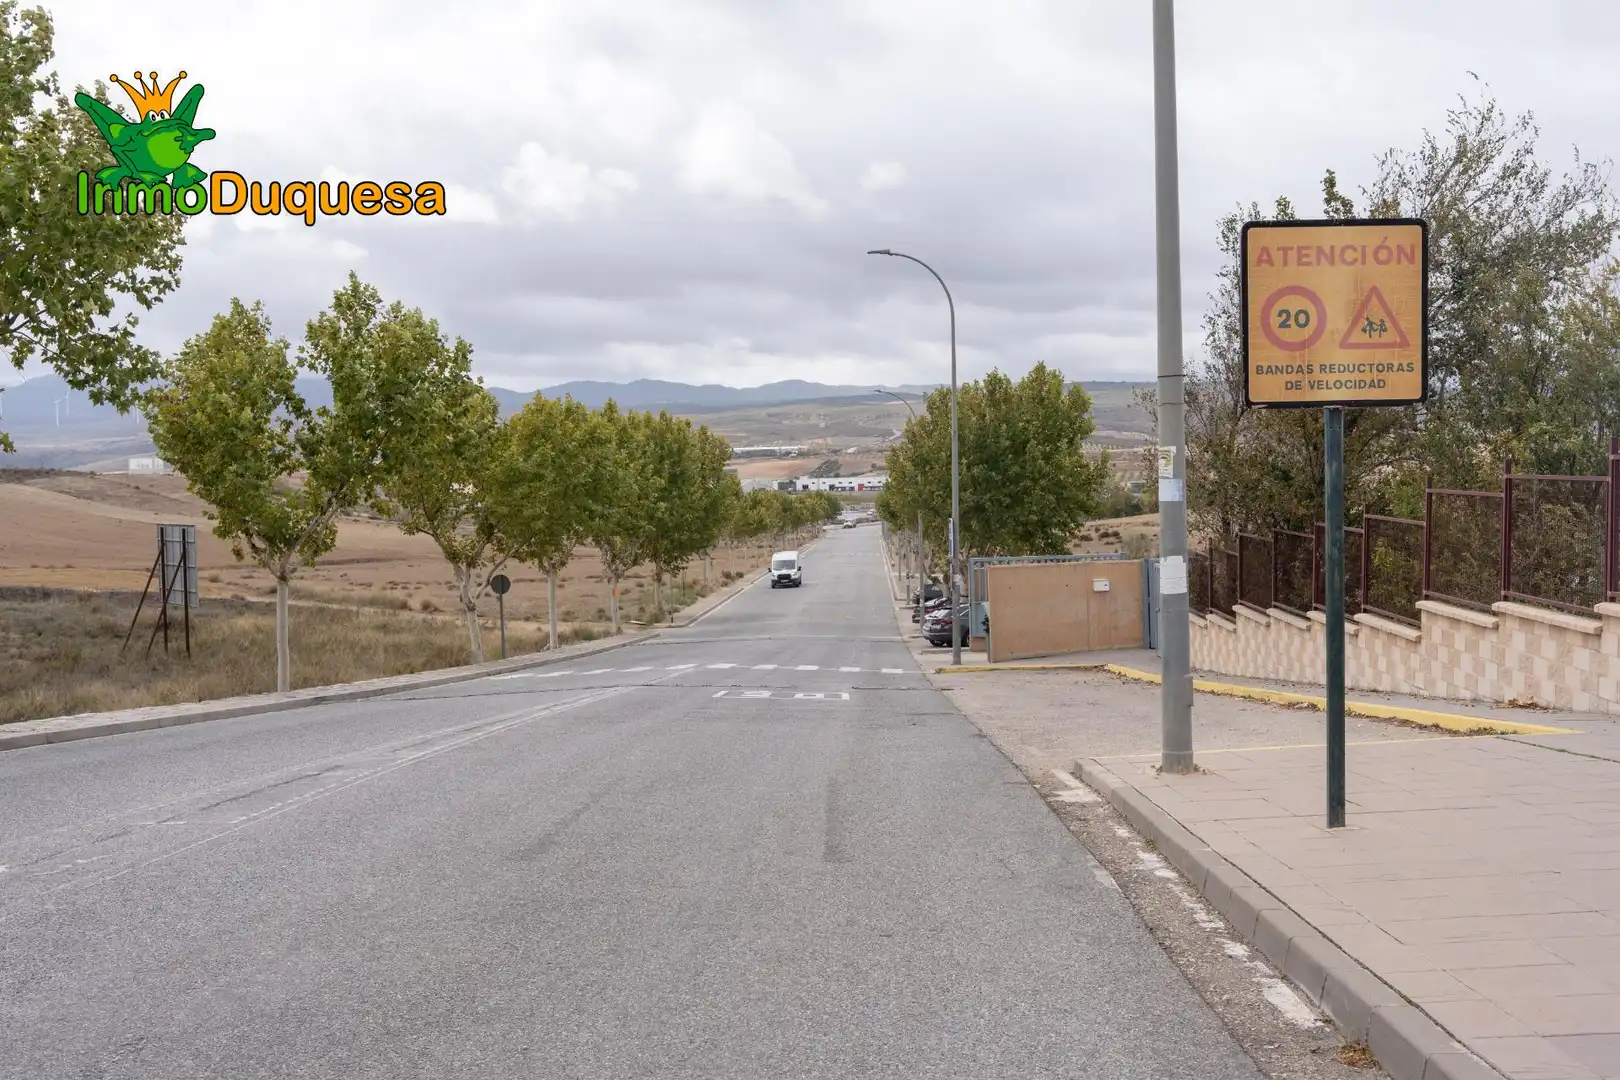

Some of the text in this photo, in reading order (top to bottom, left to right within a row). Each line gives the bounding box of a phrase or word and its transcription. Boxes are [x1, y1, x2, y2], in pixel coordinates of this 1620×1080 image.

[1256, 236, 1415, 267] ATENCIÓN
[1277, 309, 1310, 328] 20
[1256, 362, 1415, 375] BANDAS REDUCTORAS
[1285, 379, 1386, 391] DE VELOCIDAD
